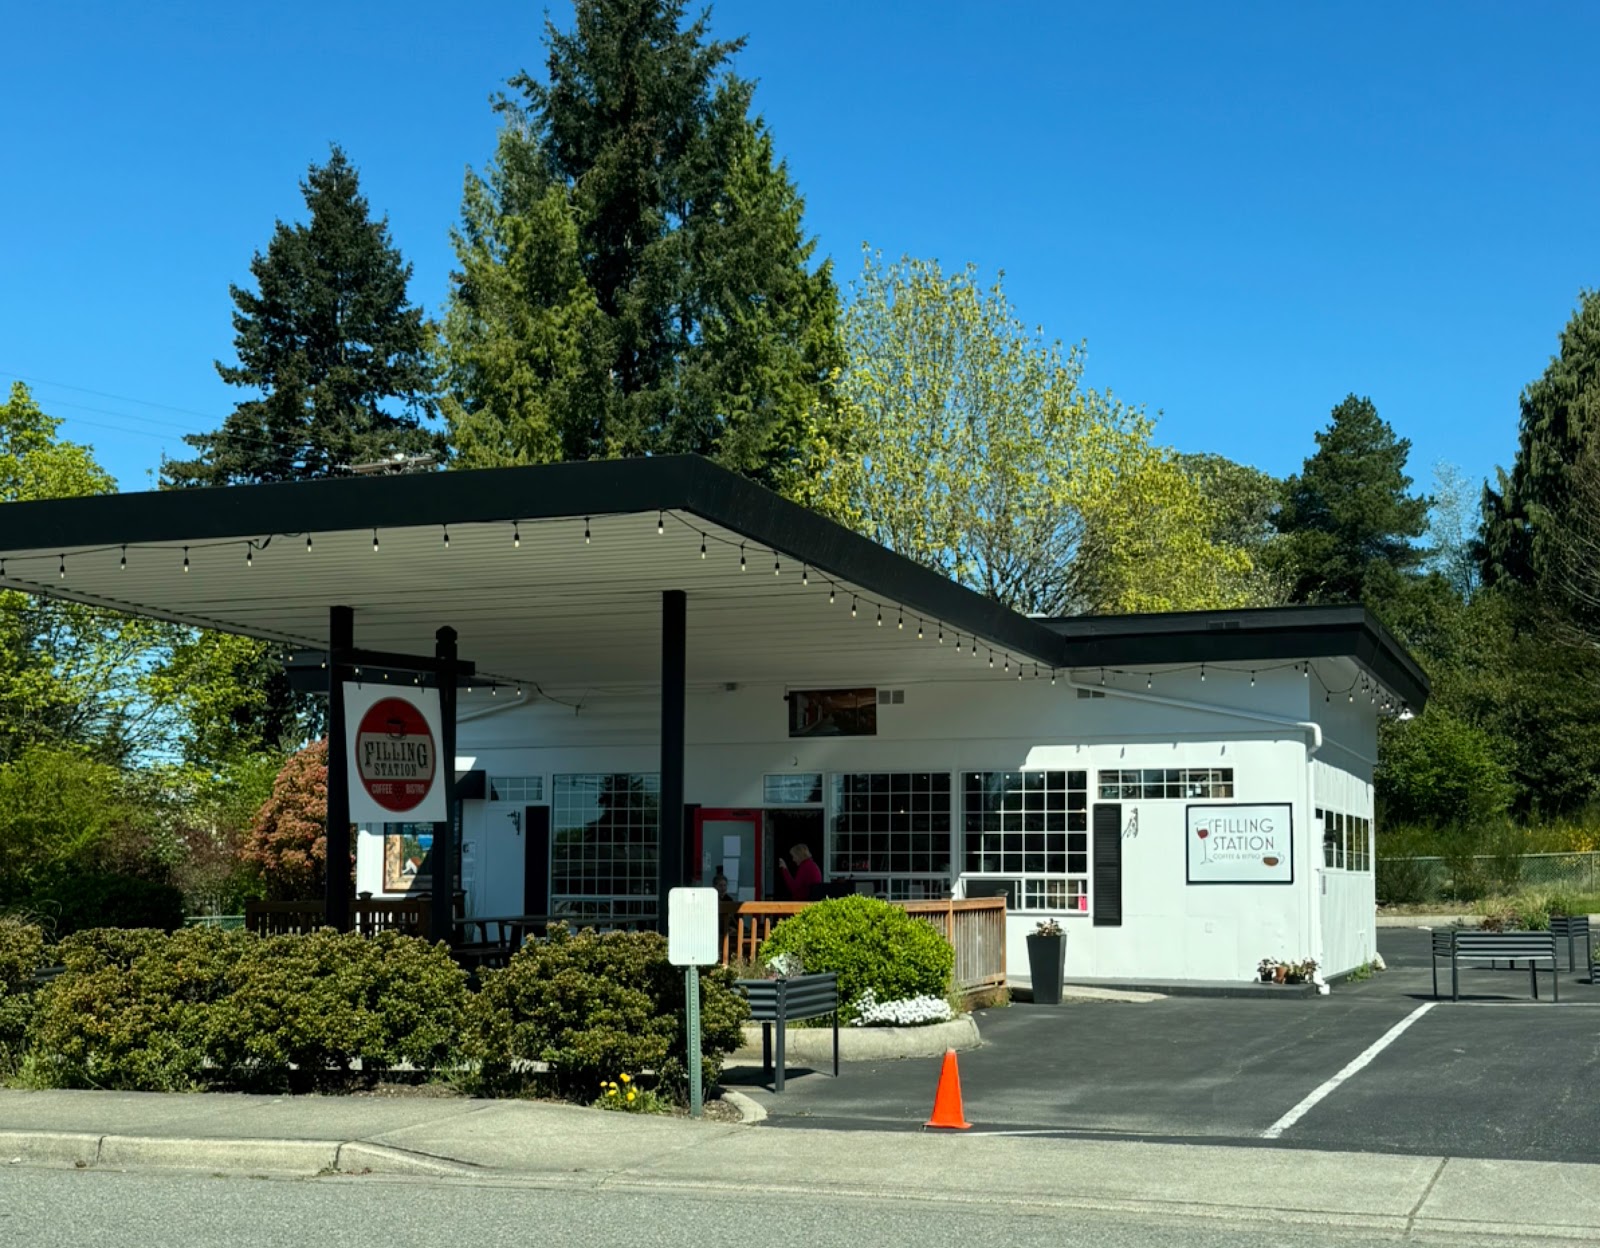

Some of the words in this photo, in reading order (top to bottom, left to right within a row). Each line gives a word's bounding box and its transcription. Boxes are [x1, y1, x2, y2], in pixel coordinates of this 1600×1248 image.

[365, 741, 428, 768] FILLING
[374, 763, 417, 777] STATION
[371, 783, 393, 795] COFFEE
[405, 784, 425, 795] BISTRO
[1214, 818, 1274, 833] FILLING
[1213, 836, 1274, 851] STATION
